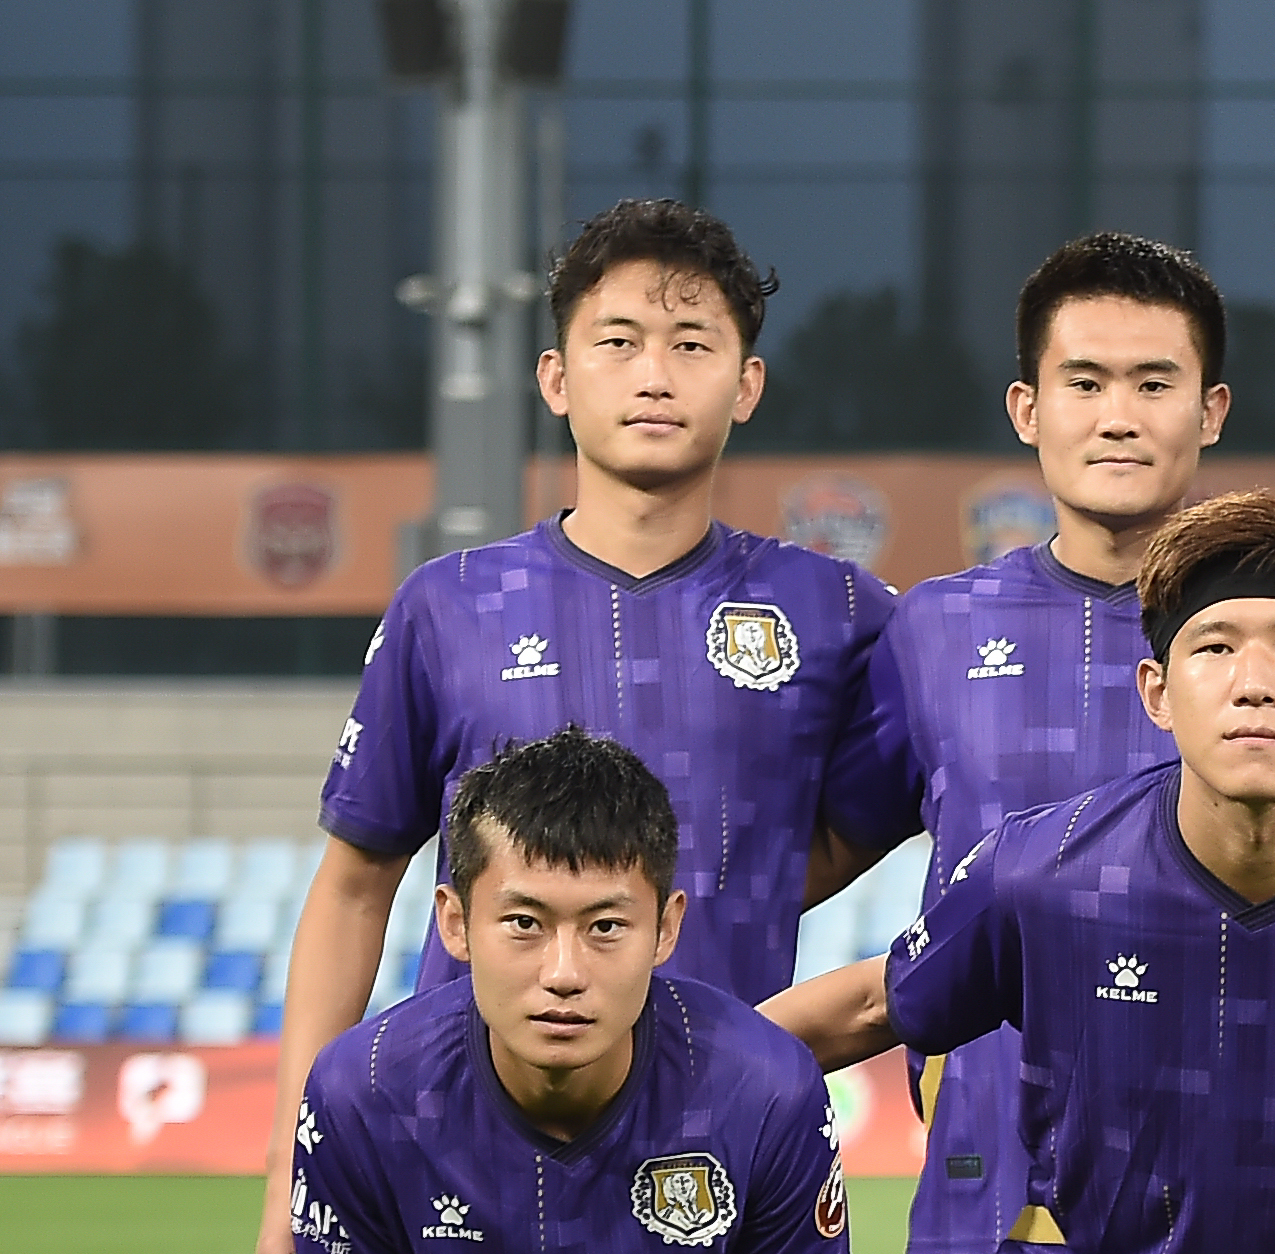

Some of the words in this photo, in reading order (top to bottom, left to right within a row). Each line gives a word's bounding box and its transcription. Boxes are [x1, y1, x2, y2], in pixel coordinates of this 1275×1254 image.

[501, 663, 560, 681] KELME
[967, 664, 1025, 679] KELME
[1096, 987, 1158, 1003] KELME
[422, 1226, 484, 1241] KELME
